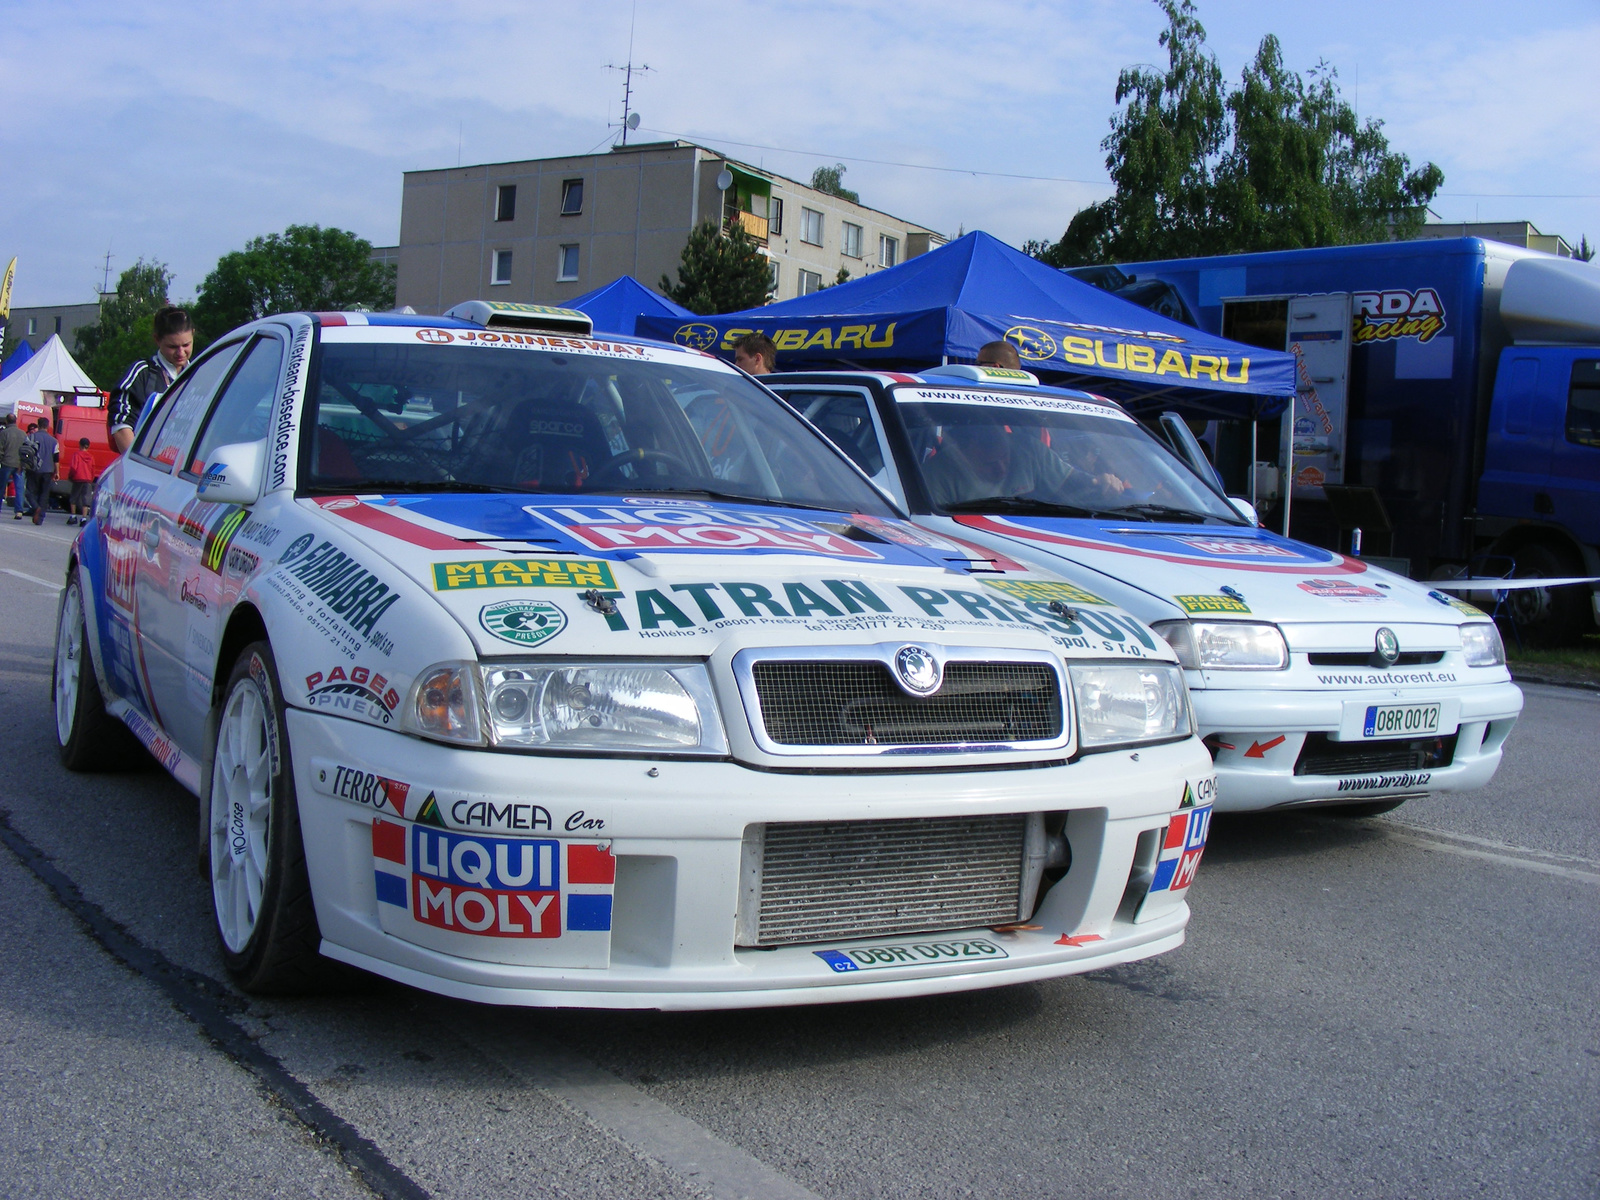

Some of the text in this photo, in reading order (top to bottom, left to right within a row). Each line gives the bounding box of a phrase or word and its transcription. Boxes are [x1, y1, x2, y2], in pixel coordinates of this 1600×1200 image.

[458, 331, 646, 356] JONNESWAY
[720, 322, 898, 350] SUBARU
[1063, 336, 1250, 384] SUBARU
[272, 324, 311, 490] www.rexteam-besedice.com
[917, 389, 1121, 418] www.rexteam-besedice.com
[529, 418, 584, 432] sparco
[552, 507, 815, 533] LIQUI
[588, 525, 844, 552] MOLY
[445, 561, 600, 575] MANN
[448, 573, 607, 587] FILTER
[985, 579, 1084, 594] MANN
[1007, 589, 1108, 604] FILTER
[576, 579, 893, 632] TATRAN
[1189, 601, 1247, 611] FILTER
[307, 615, 331, 637] 051/77
[330, 636, 341, 647] 21
[341, 647, 356, 660] 376
[315, 607, 362, 652] forfaiting
[514, 629, 548, 640] PREŠOV
[638, 628, 696, 639] Hollého
[714, 618, 756, 629] 08001
[761, 617, 808, 626] Prešov
[892, 620, 914, 630] 21
[1051, 635, 1147, 658] spol. s r.o.
[305, 666, 400, 711] PAGES
[1317, 671, 1457, 685] www.autorent.eu
[317, 694, 382, 720] PNEU
[1364, 707, 1438, 735] CZ 08R 0012
[332, 765, 390, 809] TERBO
[1337, 773, 1432, 792] www.brzdy.cz
[452, 800, 606, 832] CAMEA Car
[418, 832, 553, 889] LIQUI
[418, 880, 555, 935] MOLY
[834, 941, 998, 970] CZ 08R 0026
